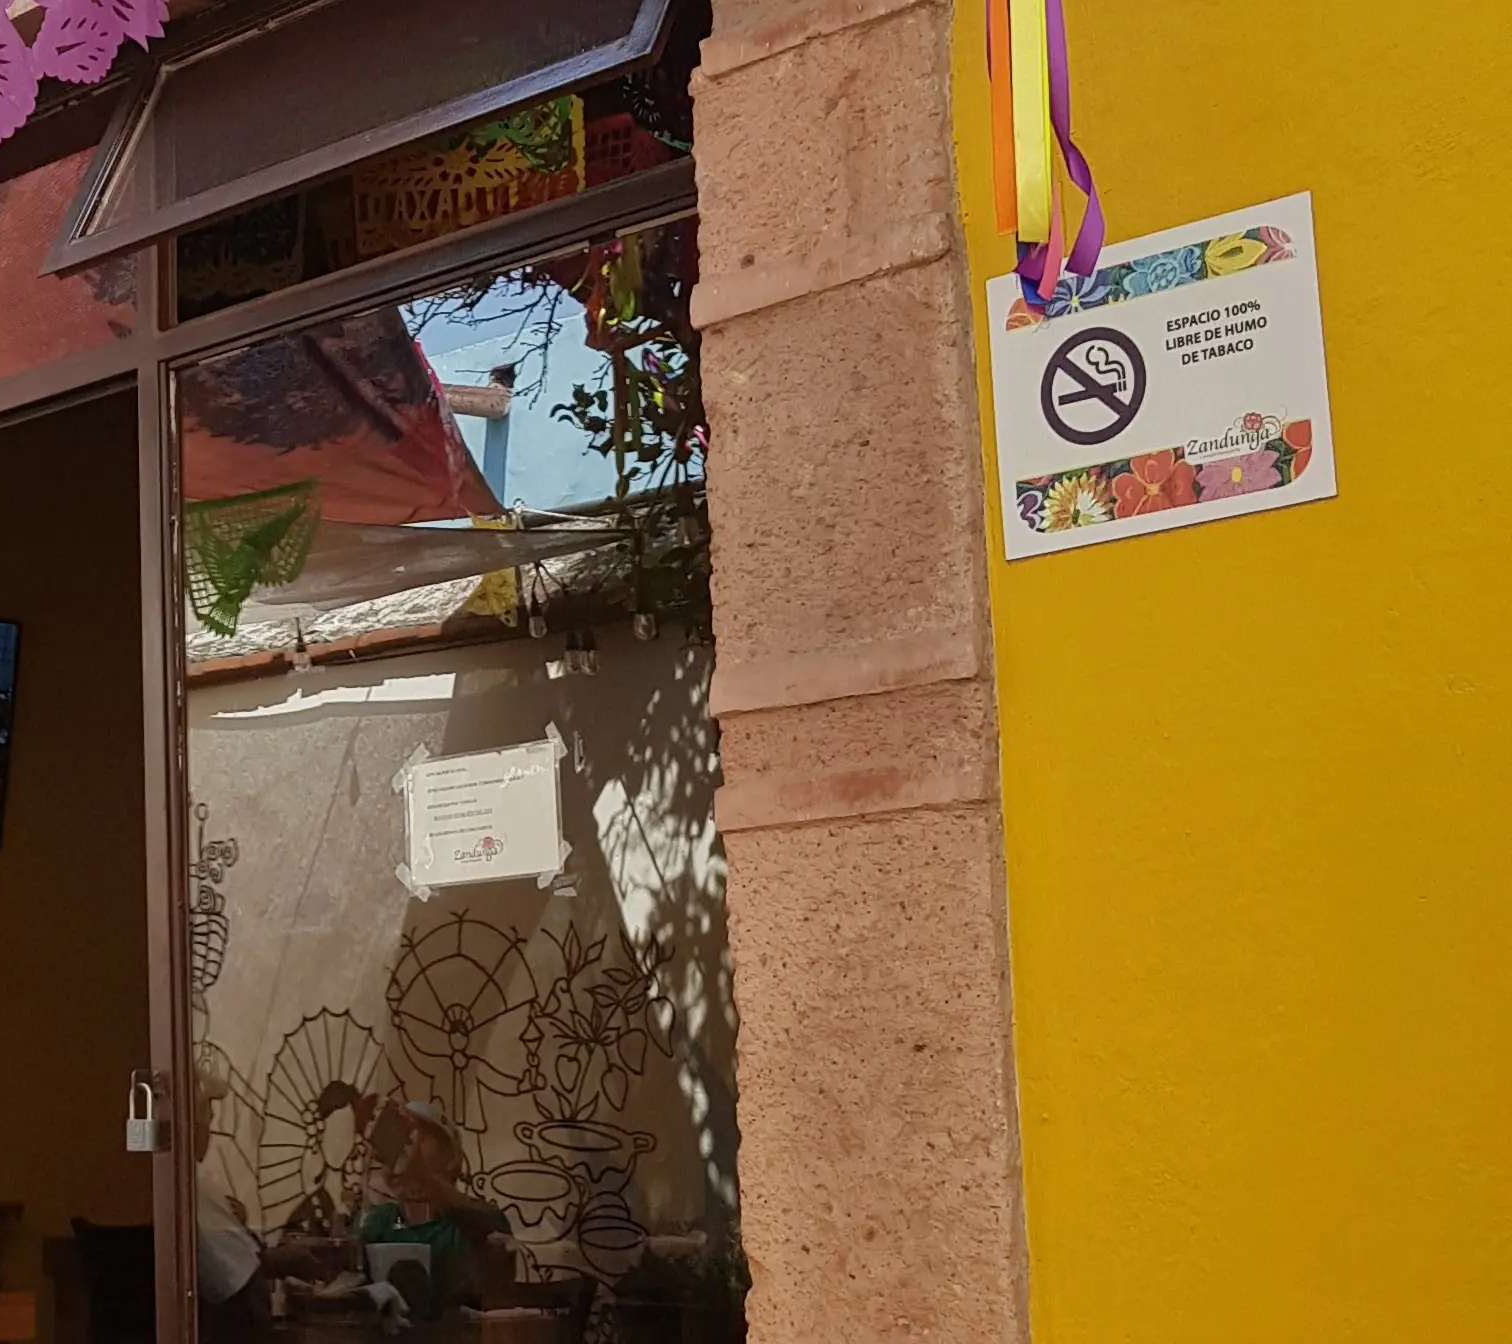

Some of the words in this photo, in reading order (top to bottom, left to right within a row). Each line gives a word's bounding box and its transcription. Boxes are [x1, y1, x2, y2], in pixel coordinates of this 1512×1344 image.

[1166, 309, 1221, 332] ESPACIO
[1224, 299, 1261, 318] 100%
[1165, 332, 1202, 351] LIBRE
[1204, 327, 1223, 342] DE
[1224, 316, 1268, 337] HUMO
[1181, 350, 1200, 365] DE
[1200, 338, 1254, 361] TABACO
[1187, 427, 1269, 456] Zandunga
